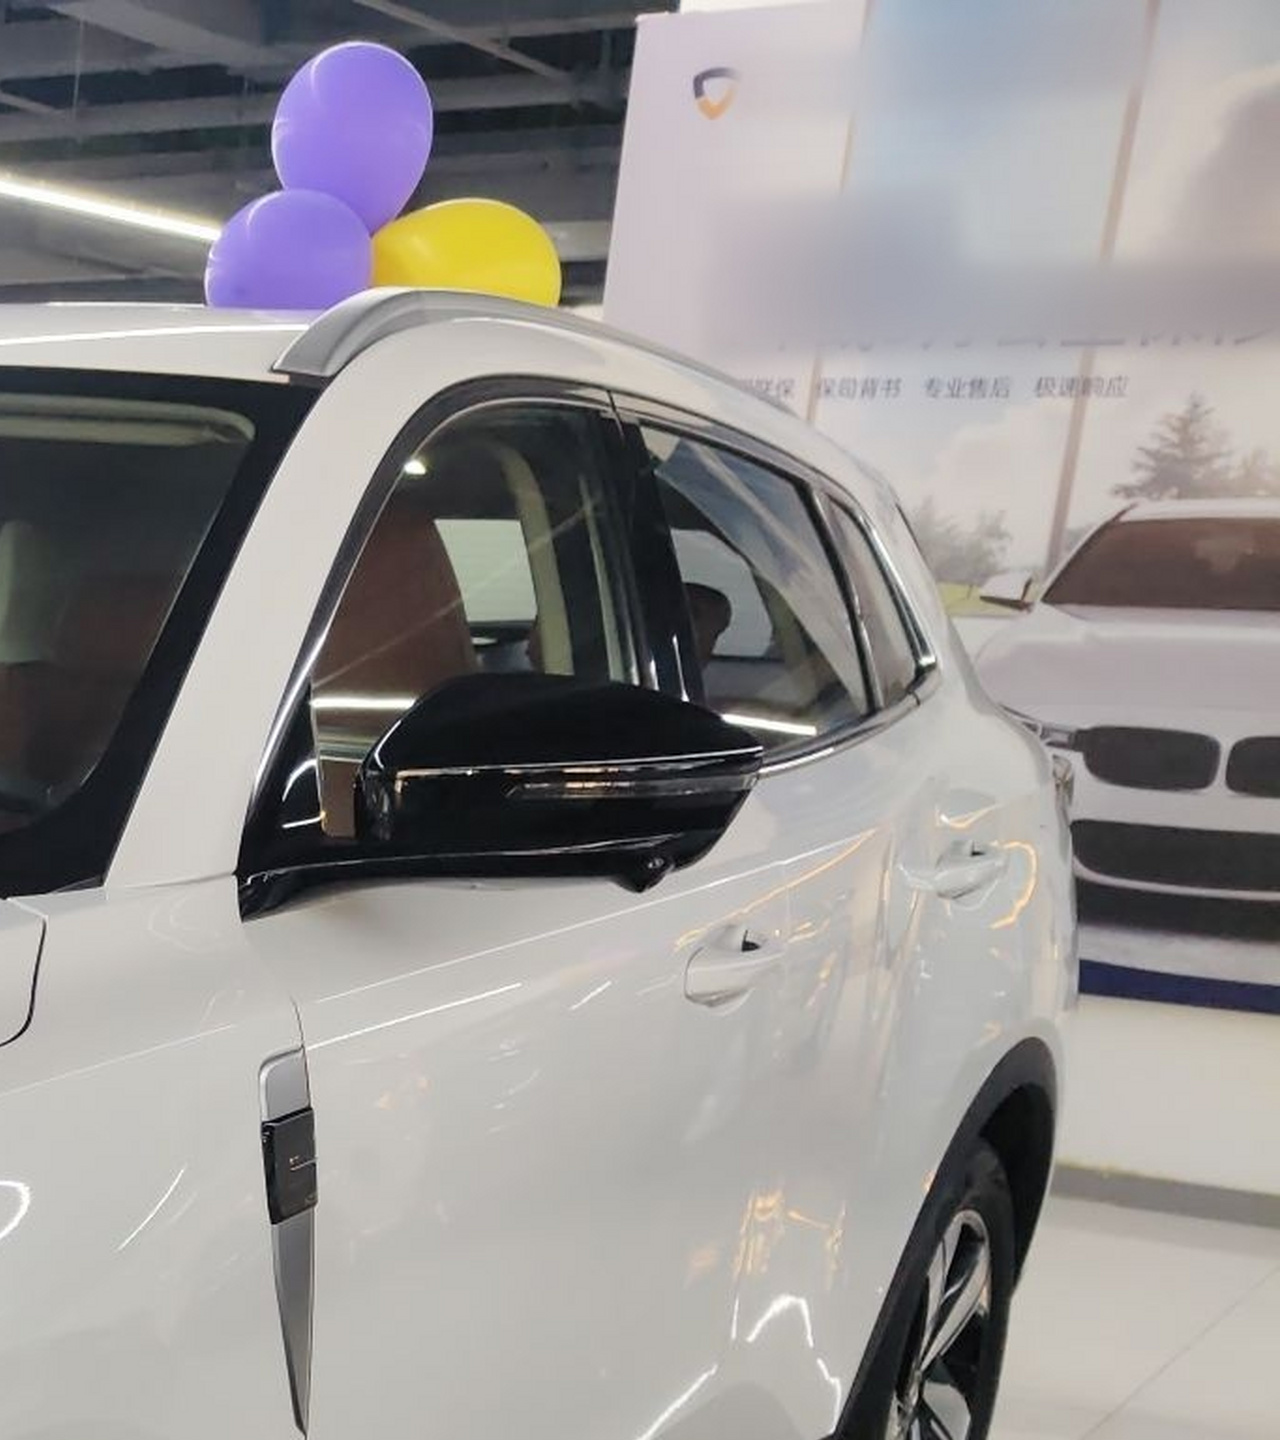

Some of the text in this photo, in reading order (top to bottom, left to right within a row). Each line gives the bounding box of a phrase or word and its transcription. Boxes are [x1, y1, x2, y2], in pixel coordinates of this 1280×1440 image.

[924, 376, 1012, 400] 专业售后
[1034, 375, 1130, 399] 极速响应
